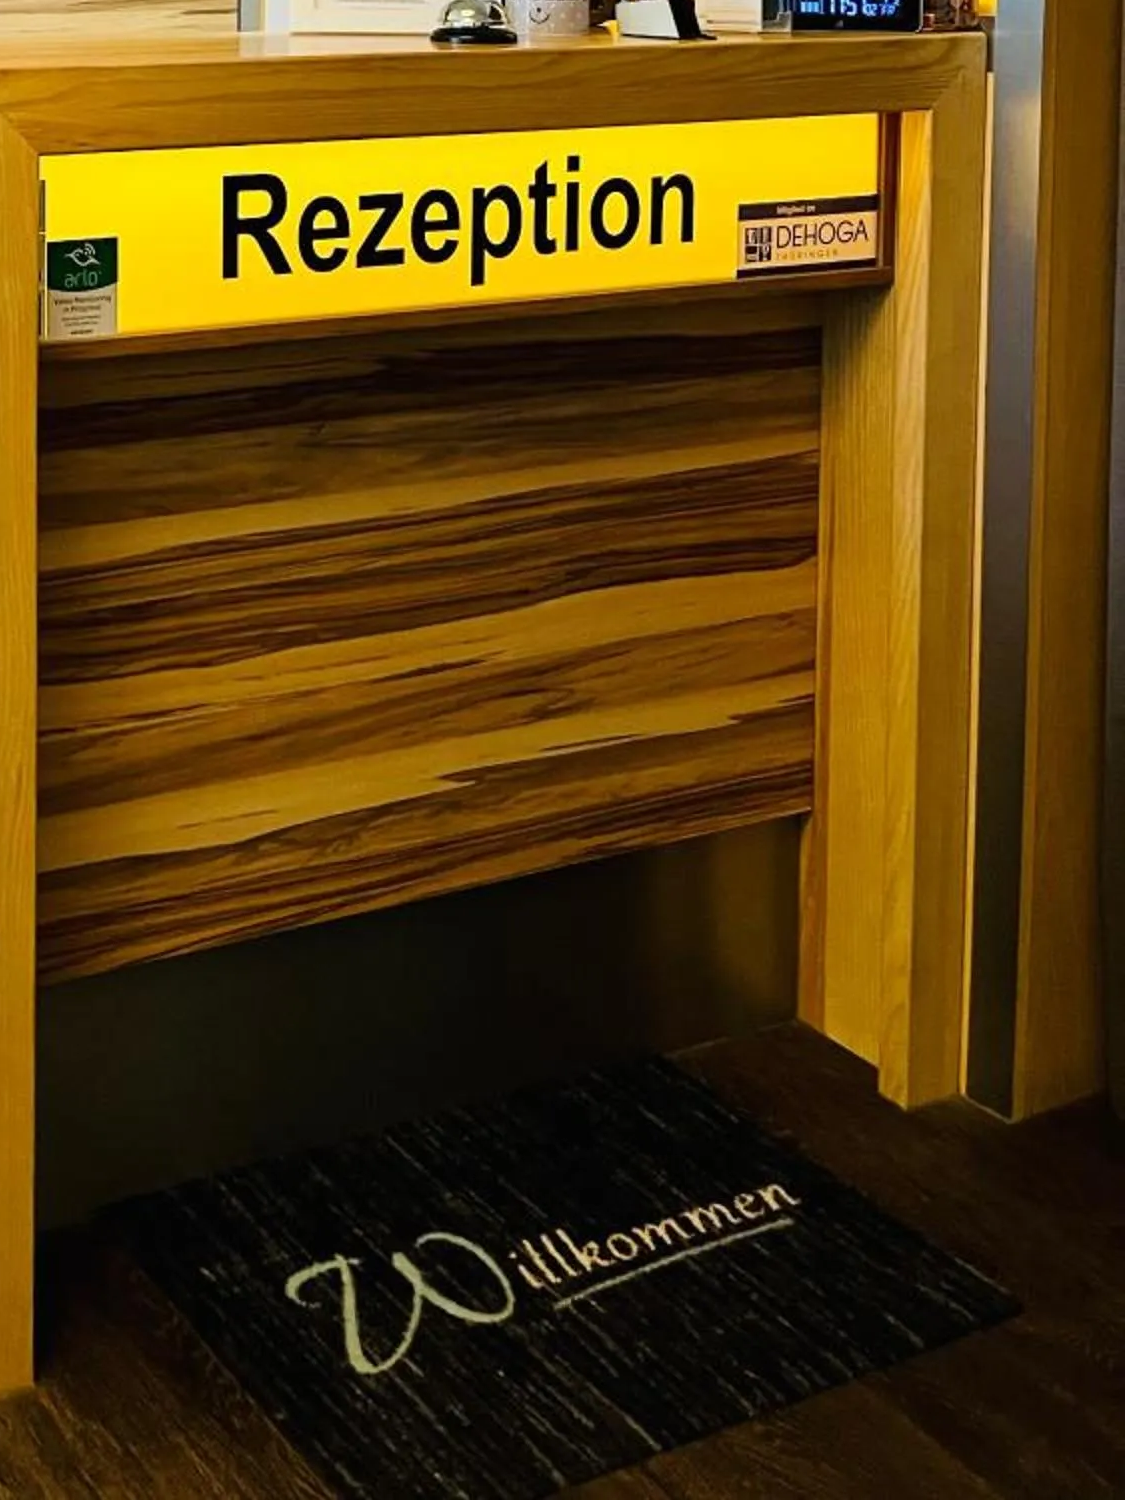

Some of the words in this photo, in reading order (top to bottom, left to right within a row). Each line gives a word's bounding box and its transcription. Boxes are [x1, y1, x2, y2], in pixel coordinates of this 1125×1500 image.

[222, 155, 695, 287] Rezeption
[776, 219, 869, 248] DEHOGA
[284, 1182, 802, 1375] Willkommen
